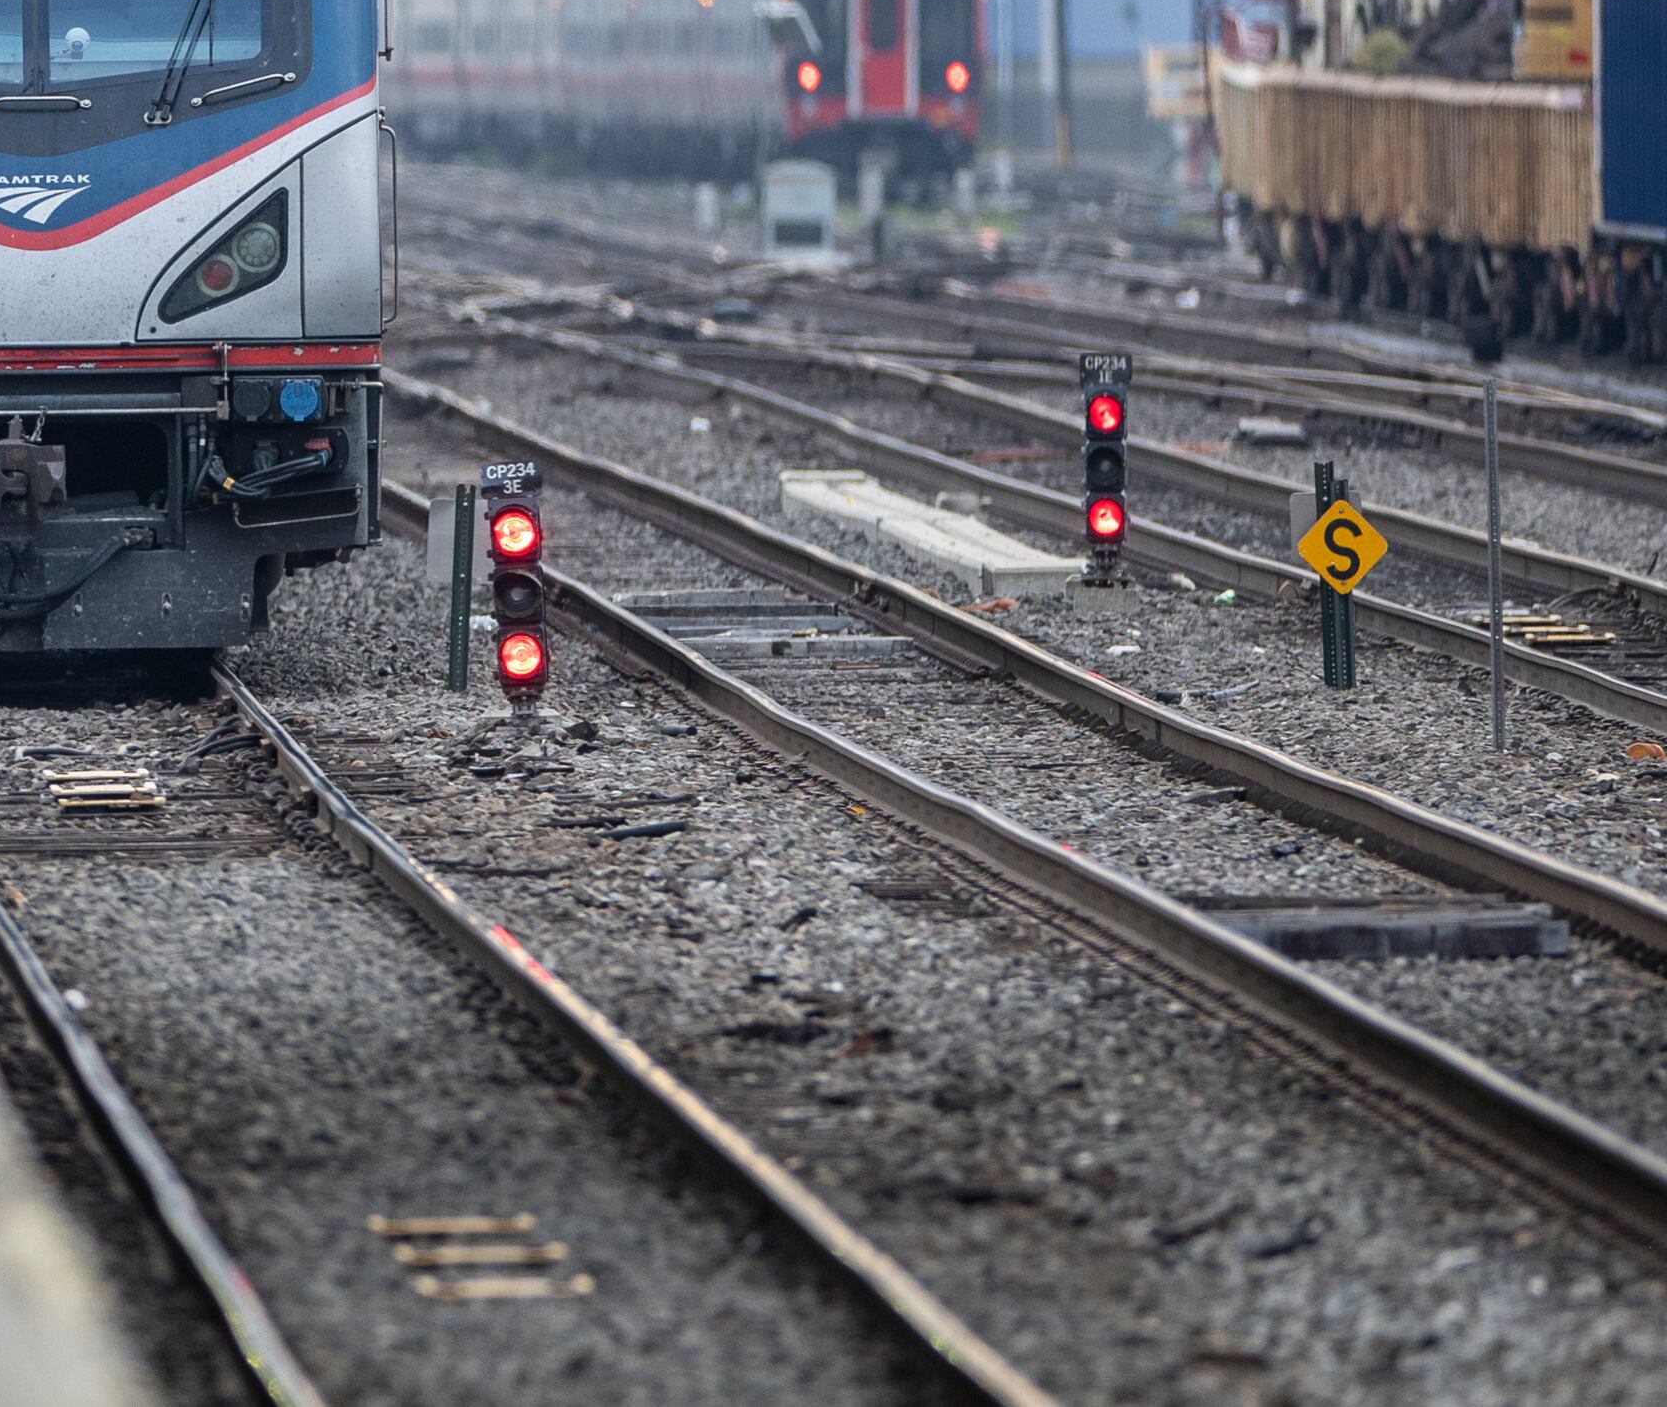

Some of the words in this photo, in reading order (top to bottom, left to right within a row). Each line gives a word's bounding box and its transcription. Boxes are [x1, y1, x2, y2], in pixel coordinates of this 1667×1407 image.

[1085, 355, 1126, 371] CP234
[486, 461, 536, 480] CP234
[503, 479, 523, 494] 3E
[1323, 518, 1363, 580] S
